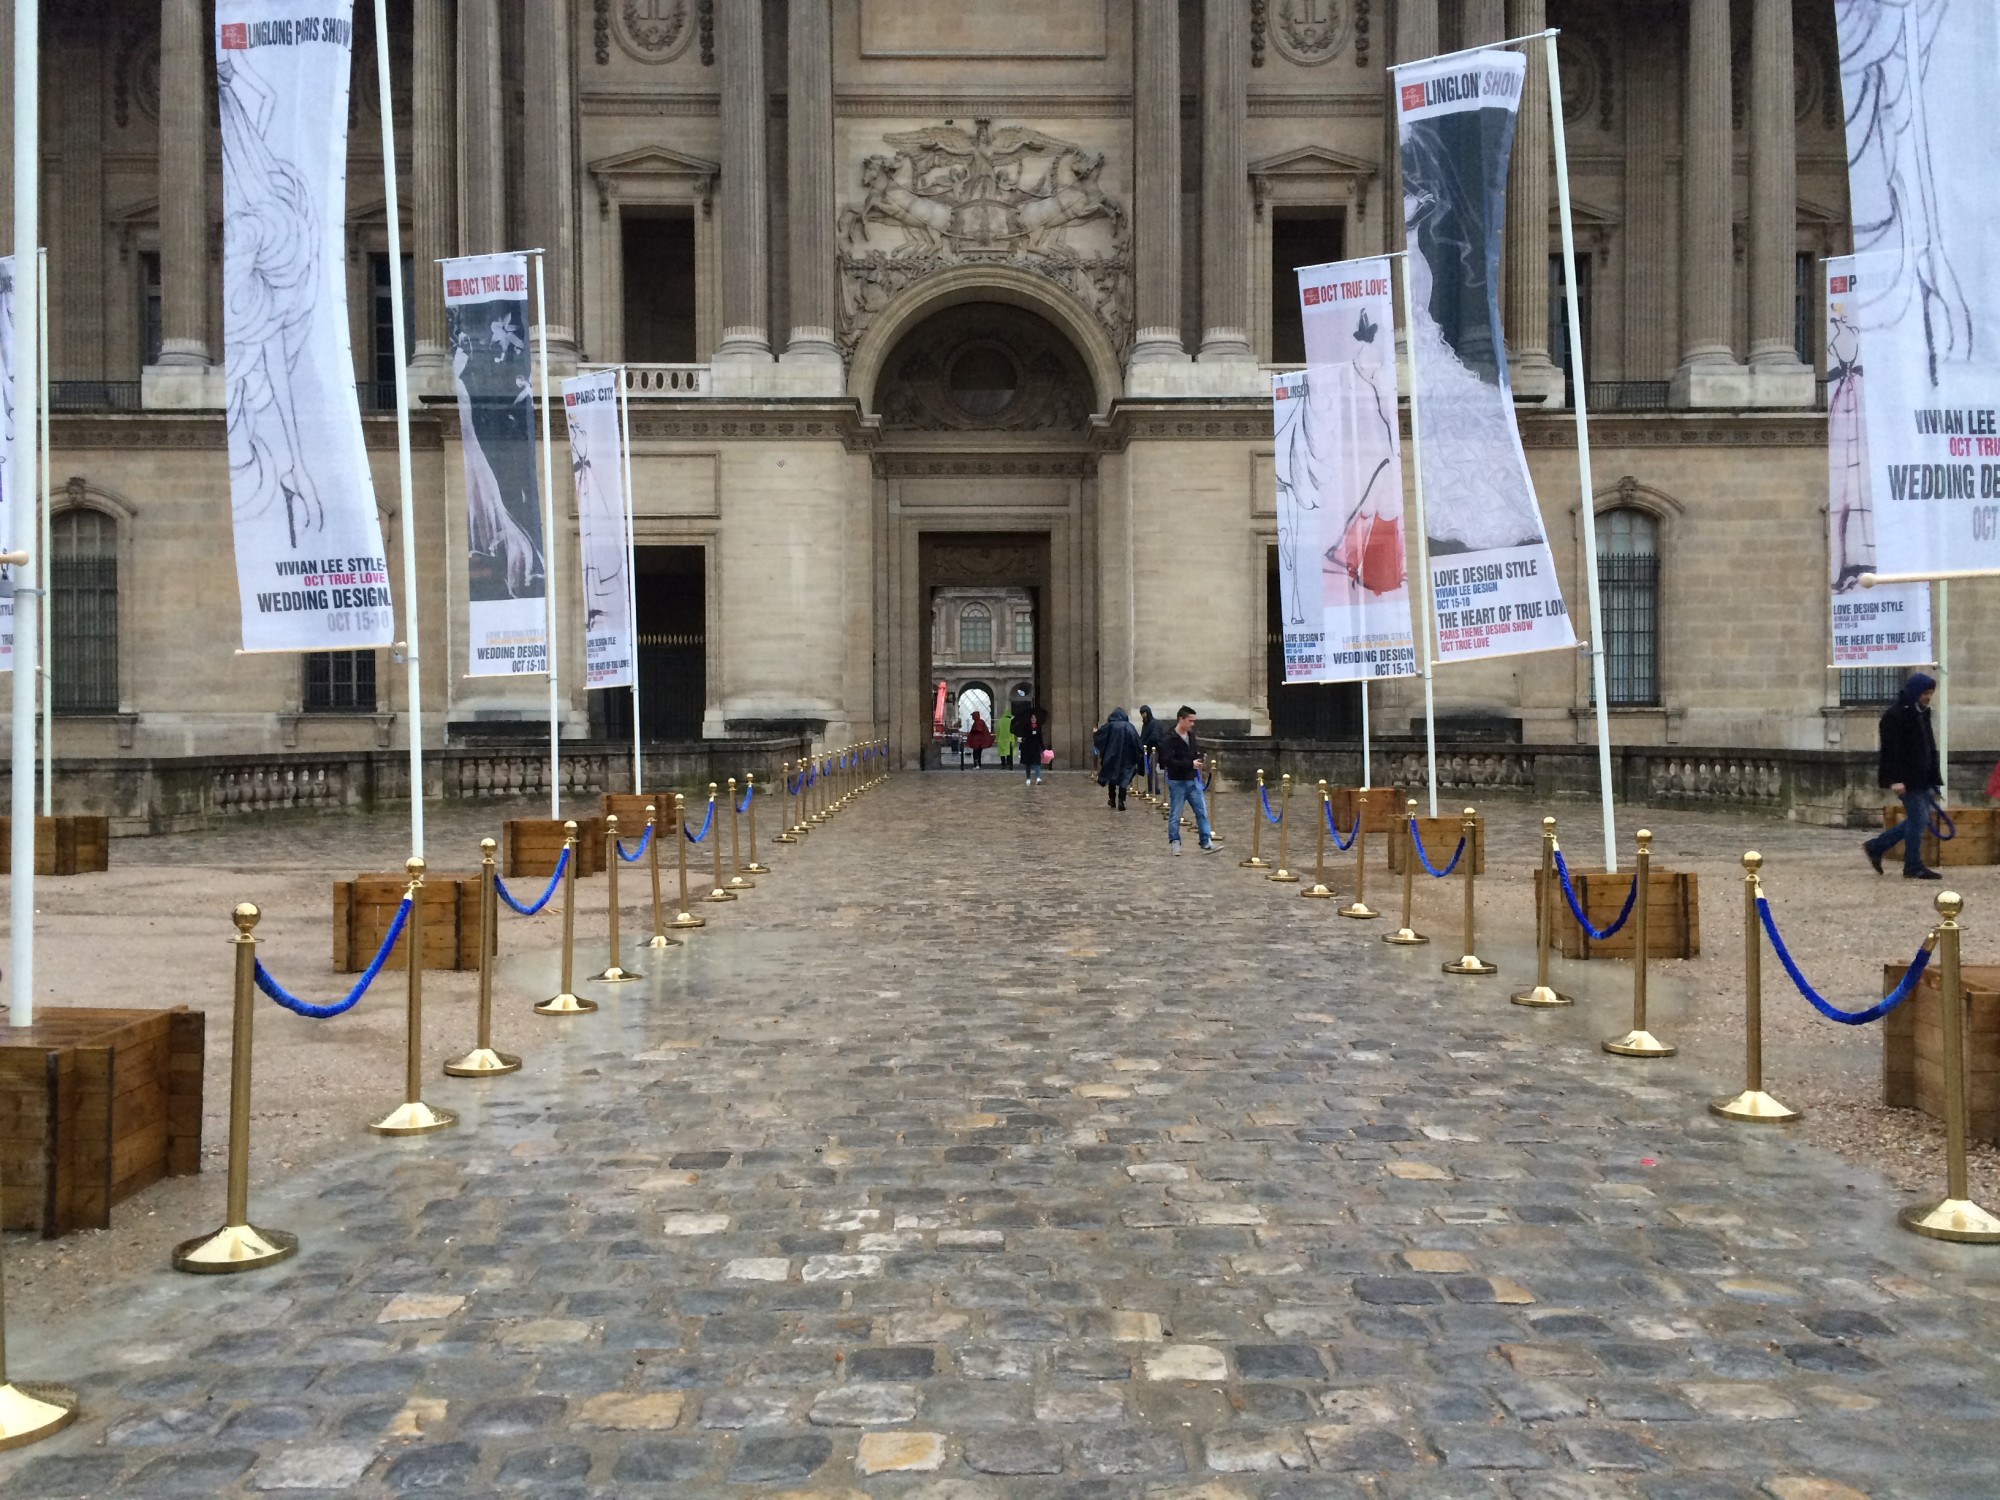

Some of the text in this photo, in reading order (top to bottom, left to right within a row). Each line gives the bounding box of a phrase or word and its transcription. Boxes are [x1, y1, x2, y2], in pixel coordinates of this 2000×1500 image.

[248, 20, 292, 49] LINGLONG
[321, 17, 351, 48] SHOW
[1425, 71, 1521, 106] LINGLON SHOW
[463, 277, 480, 296] OCT
[503, 274, 524, 292] LOVE
[1320, 279, 1388, 303] OCT TRUE LOVE
[576, 387, 613, 405] PARIS CITY
[1914, 410, 1996, 435] VIVIAN LEE
[1949, 437, 1972, 456] OCT
[1888, 464, 1975, 500] WEDDING
[1973, 505, 1999, 541] OCT
[276, 558, 384, 576] VIVIAN LEE STYLE
[1434, 559, 1537, 587] LOVE DESIGN STYLE
[304, 572, 385, 586] OCT TRUE LOVE
[1435, 582, 1498, 598] VIVIAN LEE DESIGN
[257, 587, 388, 612] WEDDING DESIGN
[1437, 597, 1470, 610] OCT 15-10
[1834, 601, 1904, 615] LOVE DESIGN STYLE
[327, 610, 389, 632] OCT 15-10
[1438, 599, 1566, 629] THE HEART OF TRUE LOV
[1285, 634, 1297, 642] LOVE
[1299, 633, 1318, 642] DESIGN
[1440, 620, 1532, 640] PARIS THEME DESIGN SHOW
[1835, 631, 1926, 646] THE HEART OF TRUE LOVE
[477, 645, 546, 660] WEDDING DESIGN
[1441, 637, 1490, 652] OCT TRUE LOVE
[1286, 655, 1322, 664] THE HEART OF
[1333, 648, 1414, 664] WEDDING DESIGN
[512, 659, 545, 672] OCT 15-10
[1376, 662, 1414, 676] OCT 15-10
